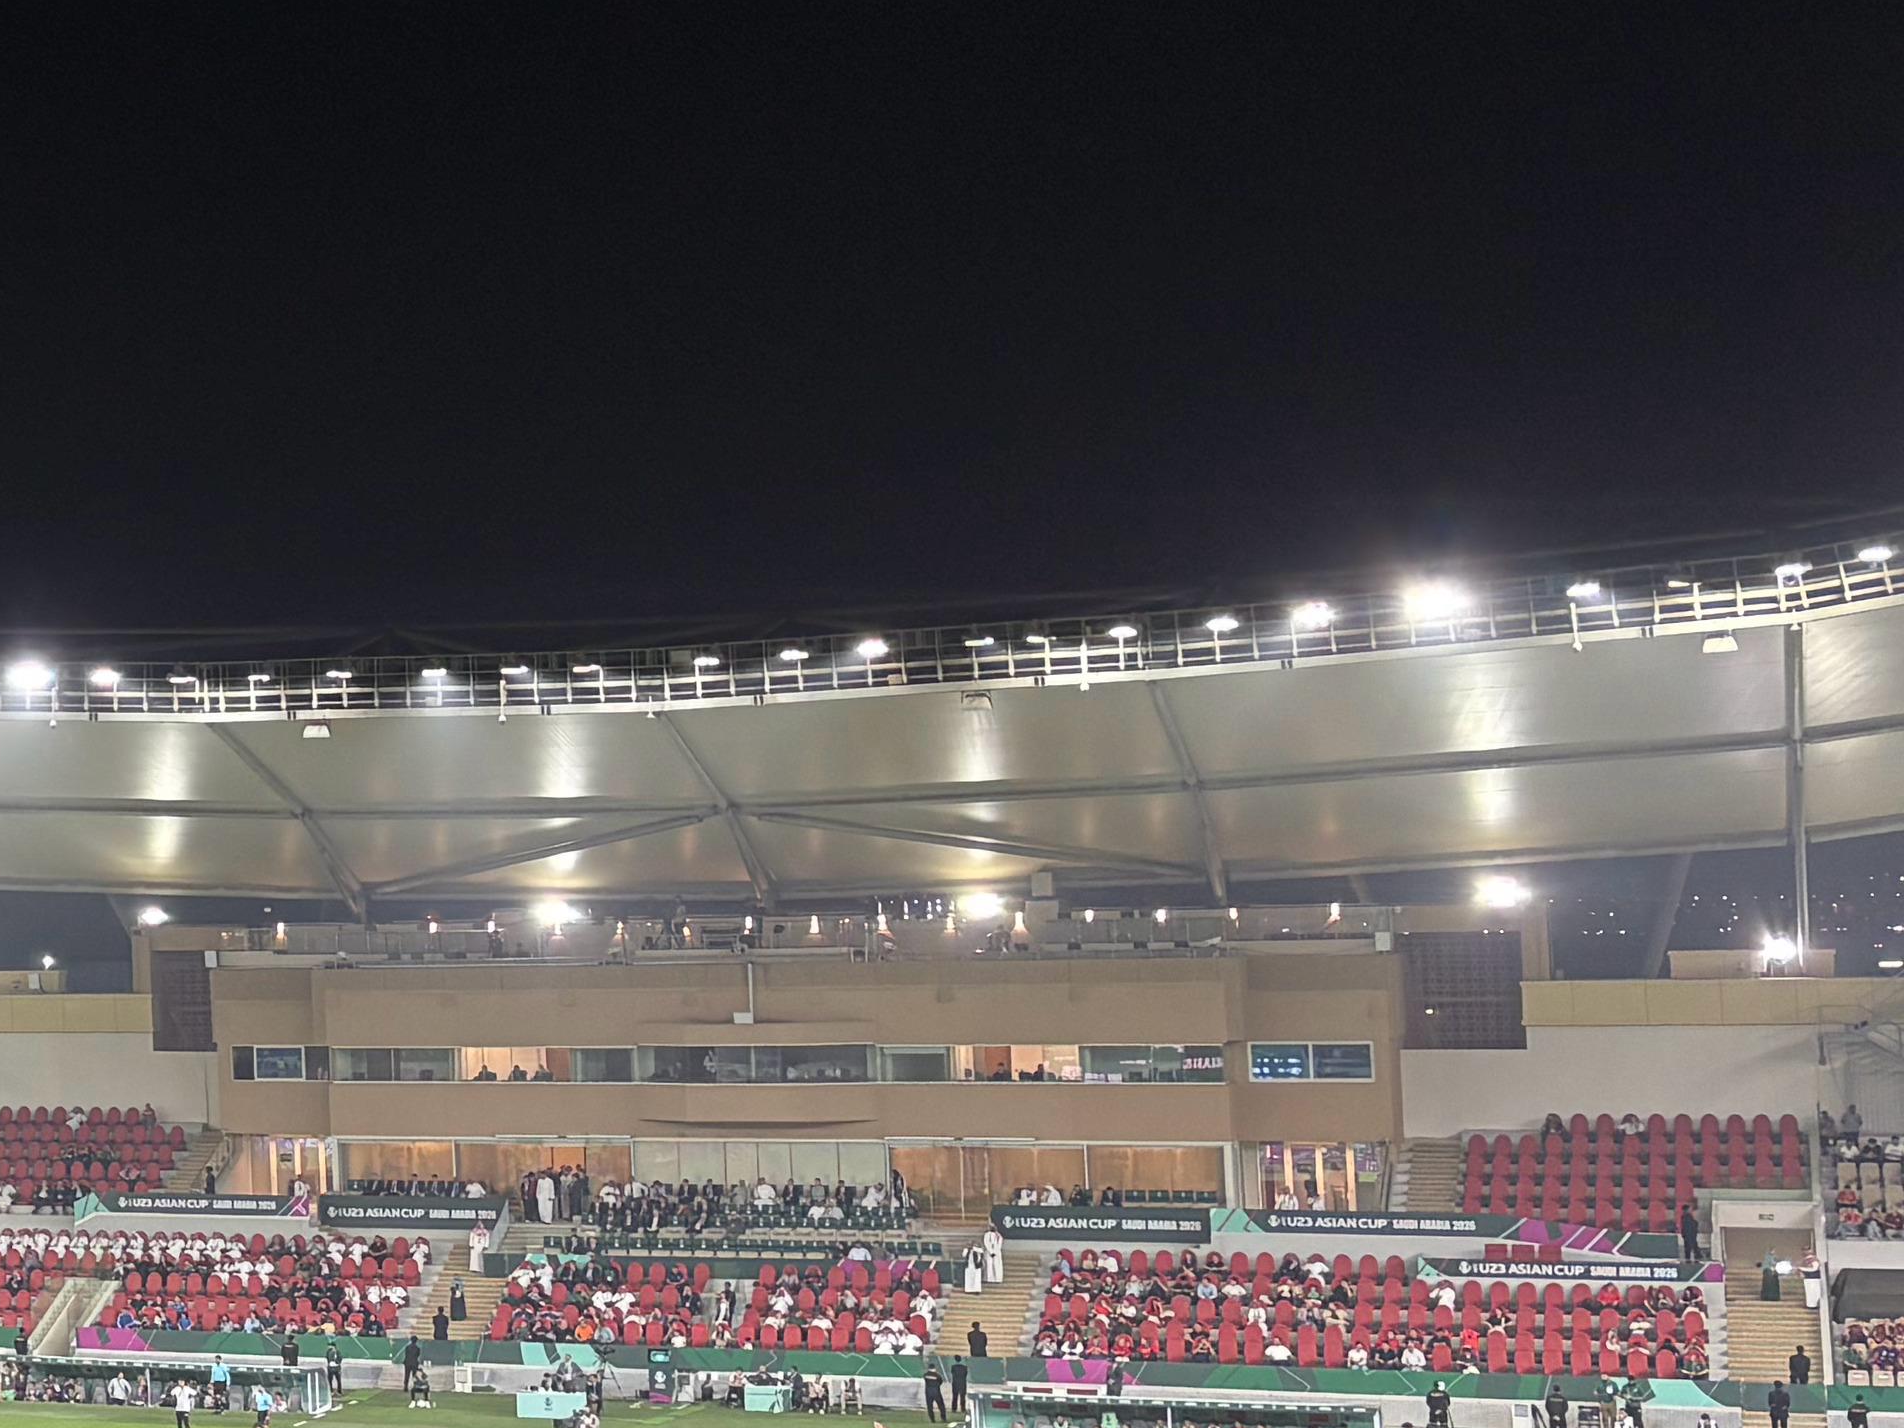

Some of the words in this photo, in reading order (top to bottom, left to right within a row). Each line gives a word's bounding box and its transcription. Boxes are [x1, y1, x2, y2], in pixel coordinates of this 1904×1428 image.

[133, 1198, 152, 1207] U23
[153, 1198, 186, 1209] ASIAN
[187, 1199, 209, 1209] CUP
[343, 1207, 364, 1217] U23
[366, 1207, 400, 1218] ASIAN
[400, 1208, 425, 1218] CUP
[1020, 1217, 1045, 1228] U23
[1047, 1217, 1087, 1229] ASIAN
[1089, 1218, 1117, 1229] CUP
[1287, 1216, 1313, 1227] U23
[1314, 1216, 1357, 1228] ASIAN
[1358, 1217, 1387, 1229] CUP
[1479, 1262, 1506, 1274] U23
[1508, 1263, 1553, 1275] ASIAN
[1553, 1264, 1585, 1276] CUP
[1653, 1266, 1678, 1278] 2026
